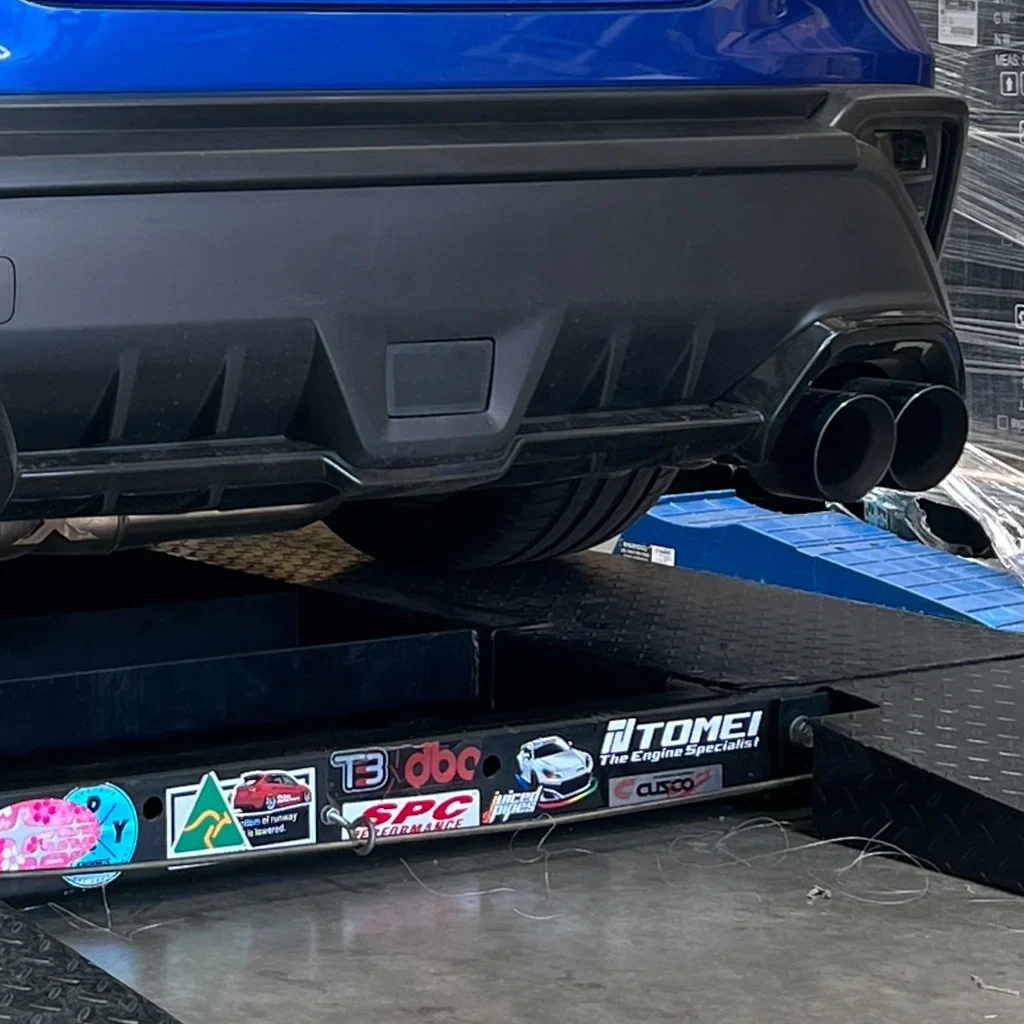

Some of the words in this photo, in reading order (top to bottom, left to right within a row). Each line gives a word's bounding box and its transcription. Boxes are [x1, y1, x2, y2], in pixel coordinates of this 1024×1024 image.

[637, 710, 763, 750] TOMEI
[404, 741, 482, 789] dbc
[599, 753, 628, 766] The
[631, 747, 683, 763] Engine
[685, 736, 760, 757] Specialist
[636, 777, 695, 797] CUSCO
[362, 795, 474, 826] SPC
[489, 802, 536, 824] pipes
